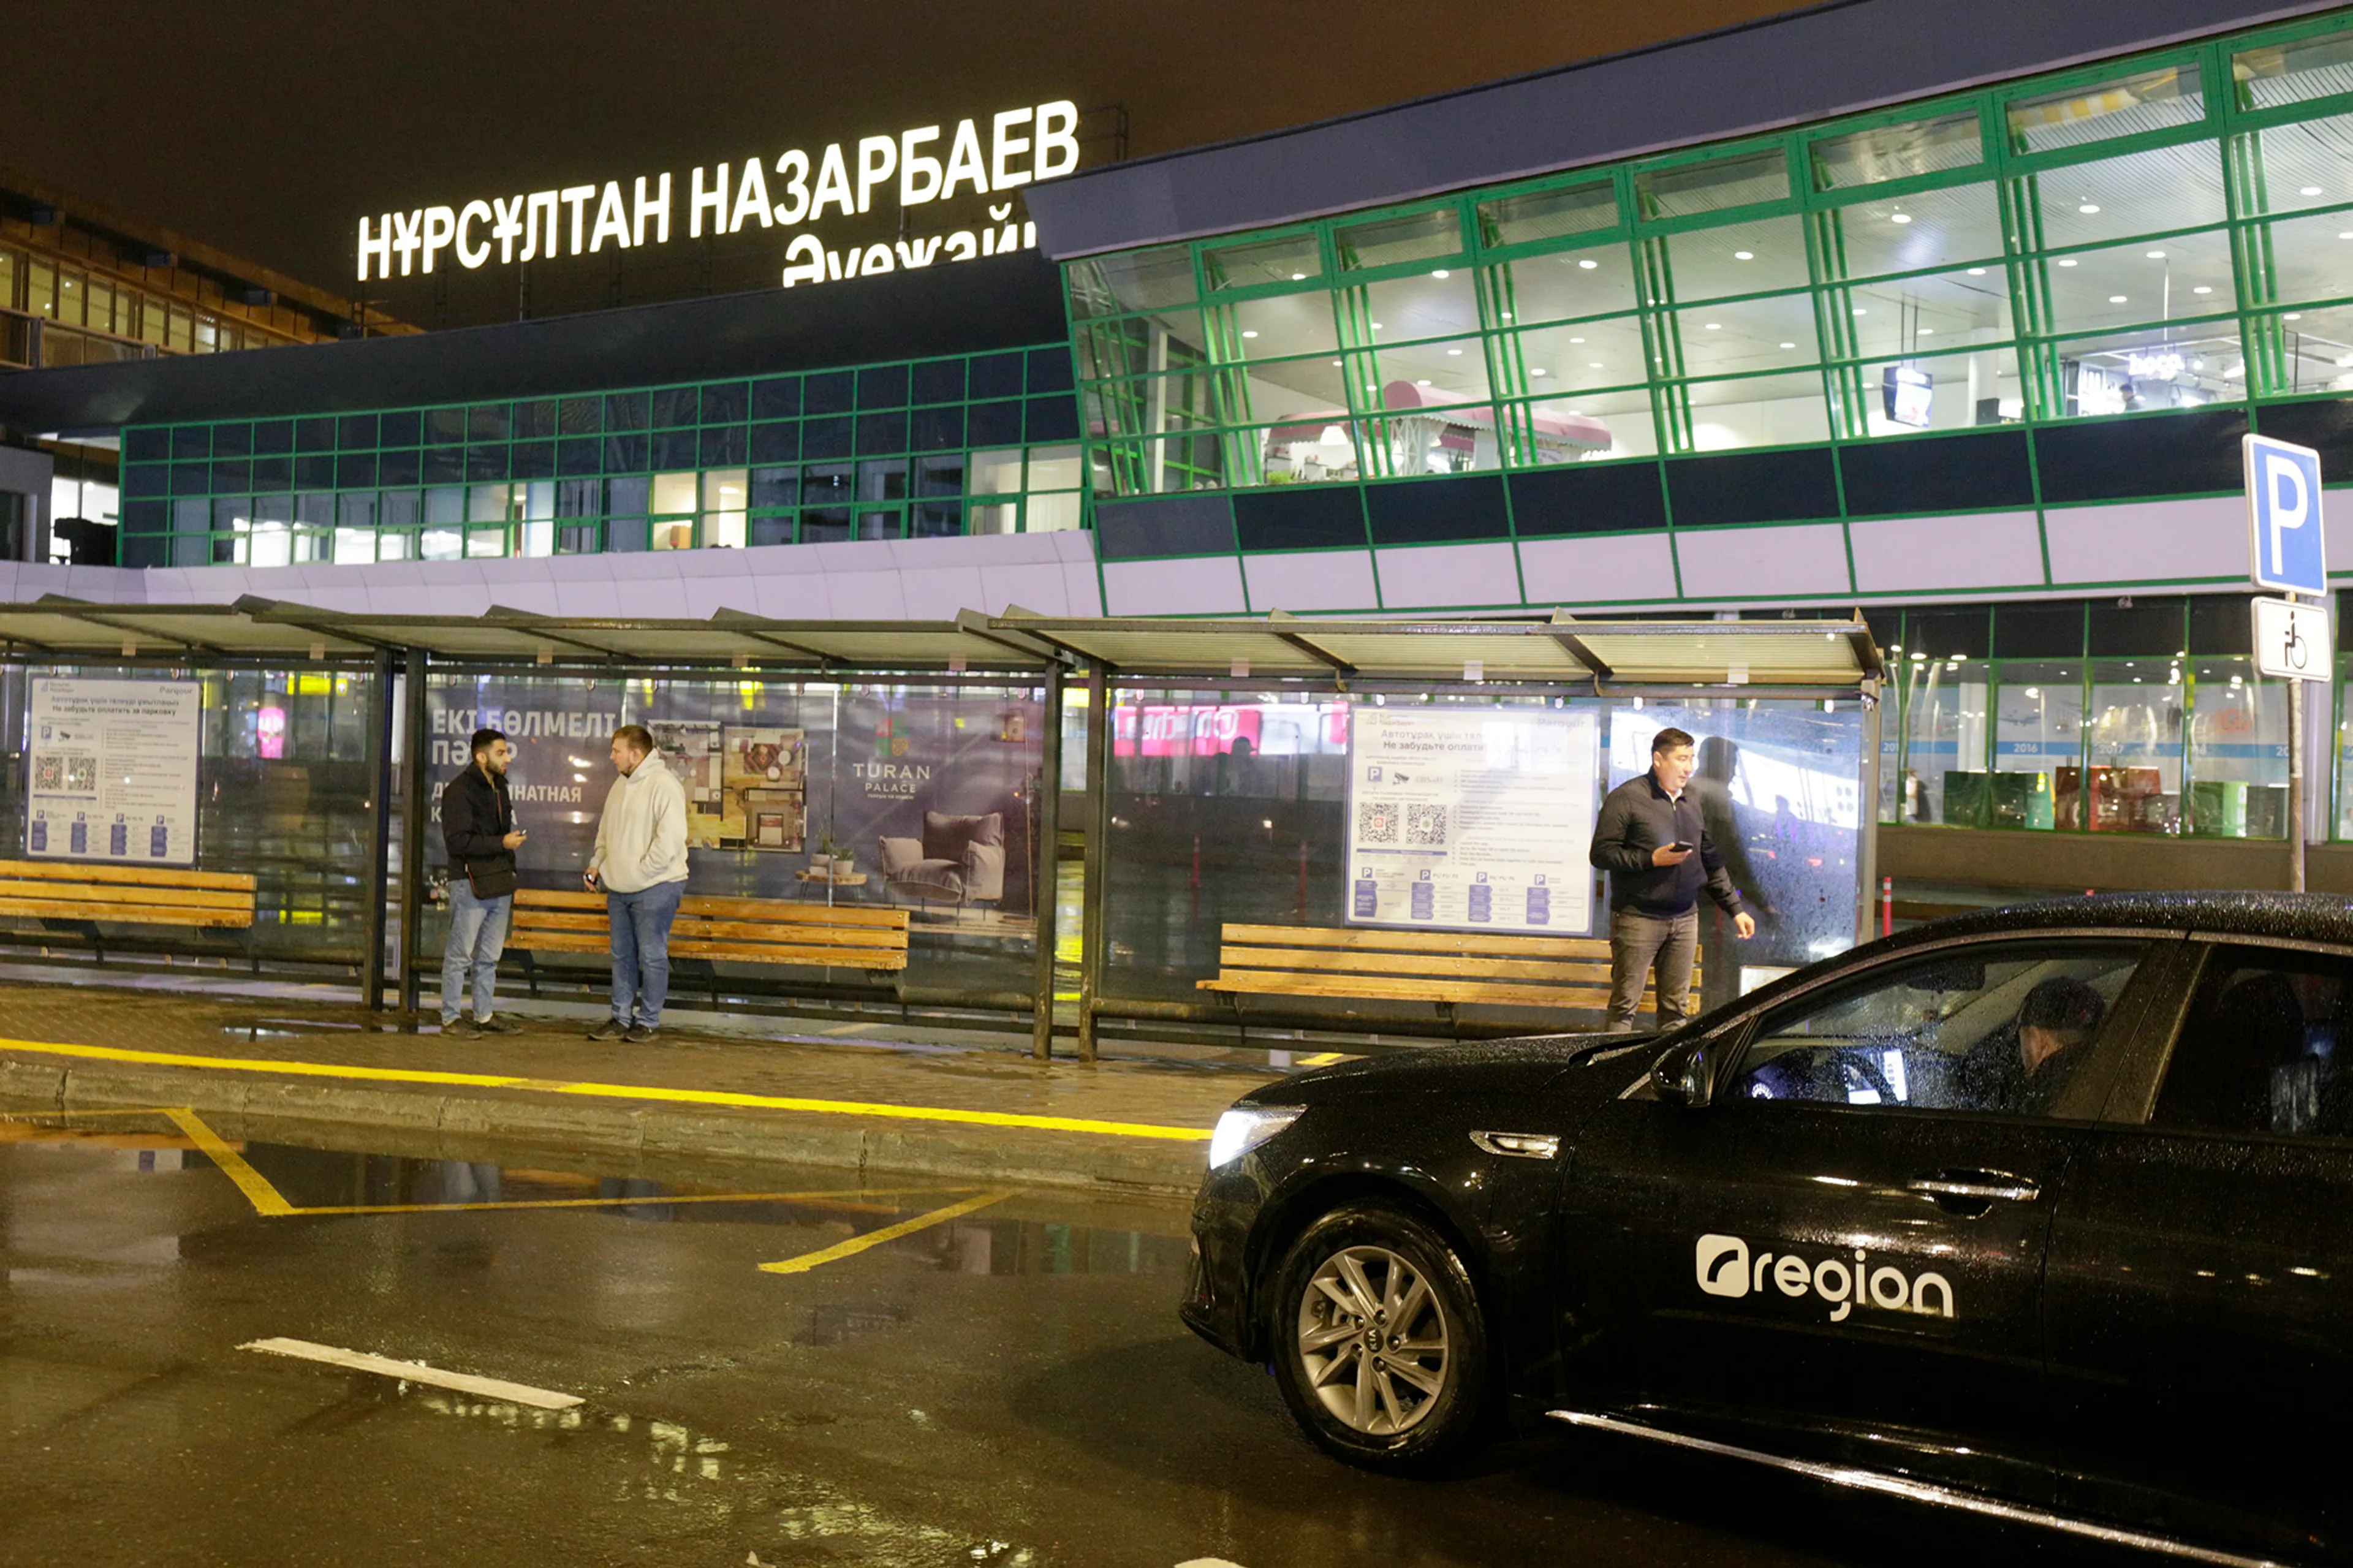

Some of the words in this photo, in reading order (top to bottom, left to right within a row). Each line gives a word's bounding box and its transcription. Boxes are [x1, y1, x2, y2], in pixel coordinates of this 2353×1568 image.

[357, 171, 672, 282] НҰРСҰЛТАН
[689, 99, 1080, 236] НАЗАРБАЕВ
[2266, 453, 2308, 575] P
[433, 709, 477, 733] ЕКІ
[487, 710, 616, 738] БӨЛМЕЛІ
[431, 740, 518, 766] ПӘР
[1384, 741, 1396, 749] Не
[1400, 741, 1445, 751] забудьте
[1882, 743, 1898, 752] 201
[2014, 743, 2038, 752] 2016
[853, 763, 930, 780] TURAN
[865, 782, 917, 793] PALACE
[1754, 1249, 1954, 1322] region
[1368, 1329, 1377, 1350] KIA
